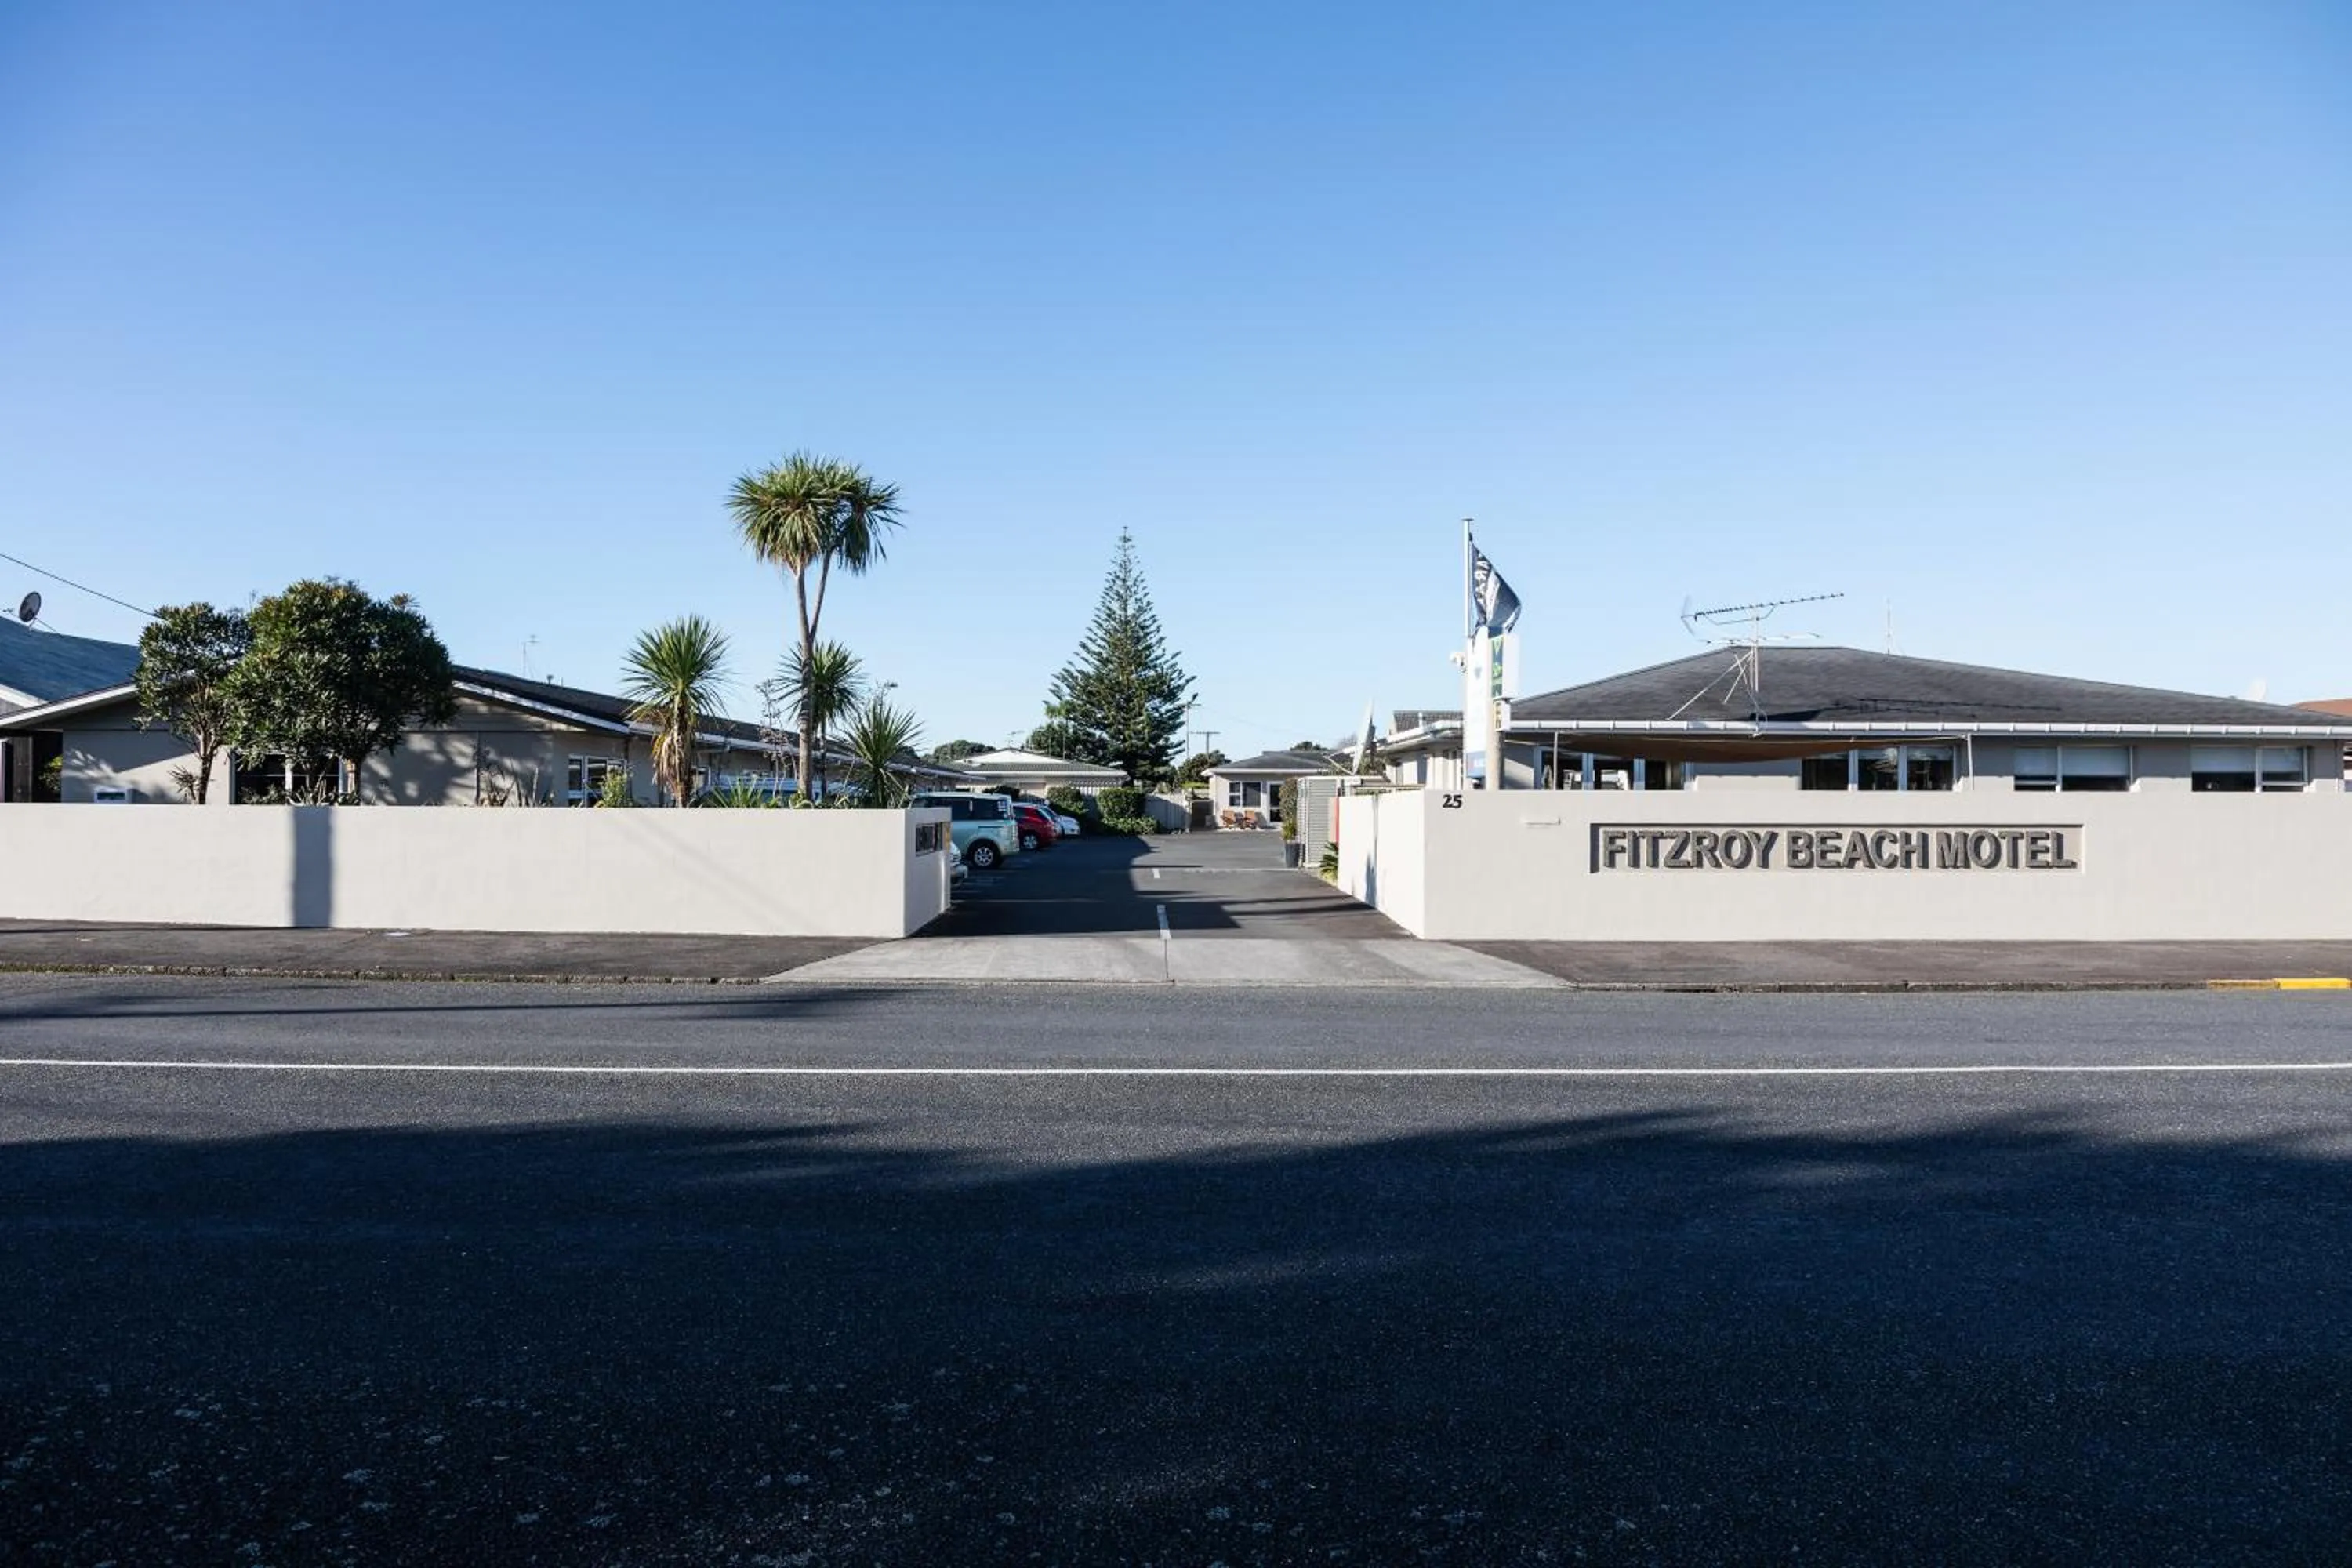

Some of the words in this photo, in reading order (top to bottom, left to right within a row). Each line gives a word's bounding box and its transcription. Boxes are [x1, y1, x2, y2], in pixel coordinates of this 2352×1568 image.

[1443, 794, 1462, 808] 25
[1602, 829, 1779, 869] FITZROY
[1787, 829, 1929, 869] BEACH
[1936, 829, 2078, 869] MOTEL
